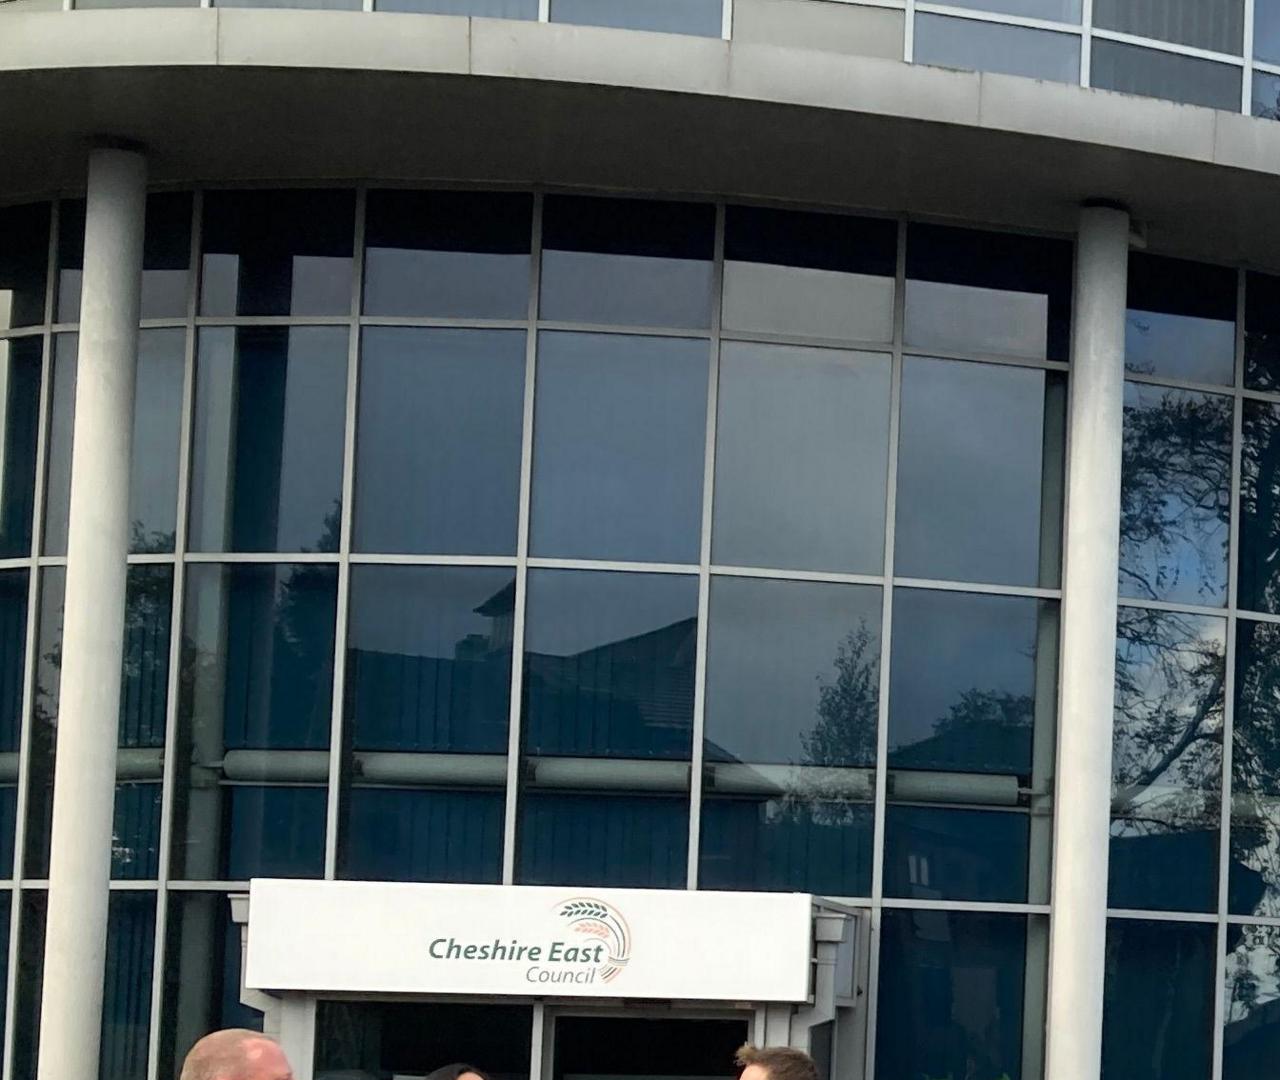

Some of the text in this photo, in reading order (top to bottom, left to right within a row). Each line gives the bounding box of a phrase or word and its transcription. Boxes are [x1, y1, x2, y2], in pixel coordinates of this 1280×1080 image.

[429, 937, 605, 964] Cheshire East
[525, 965, 597, 985] Council
